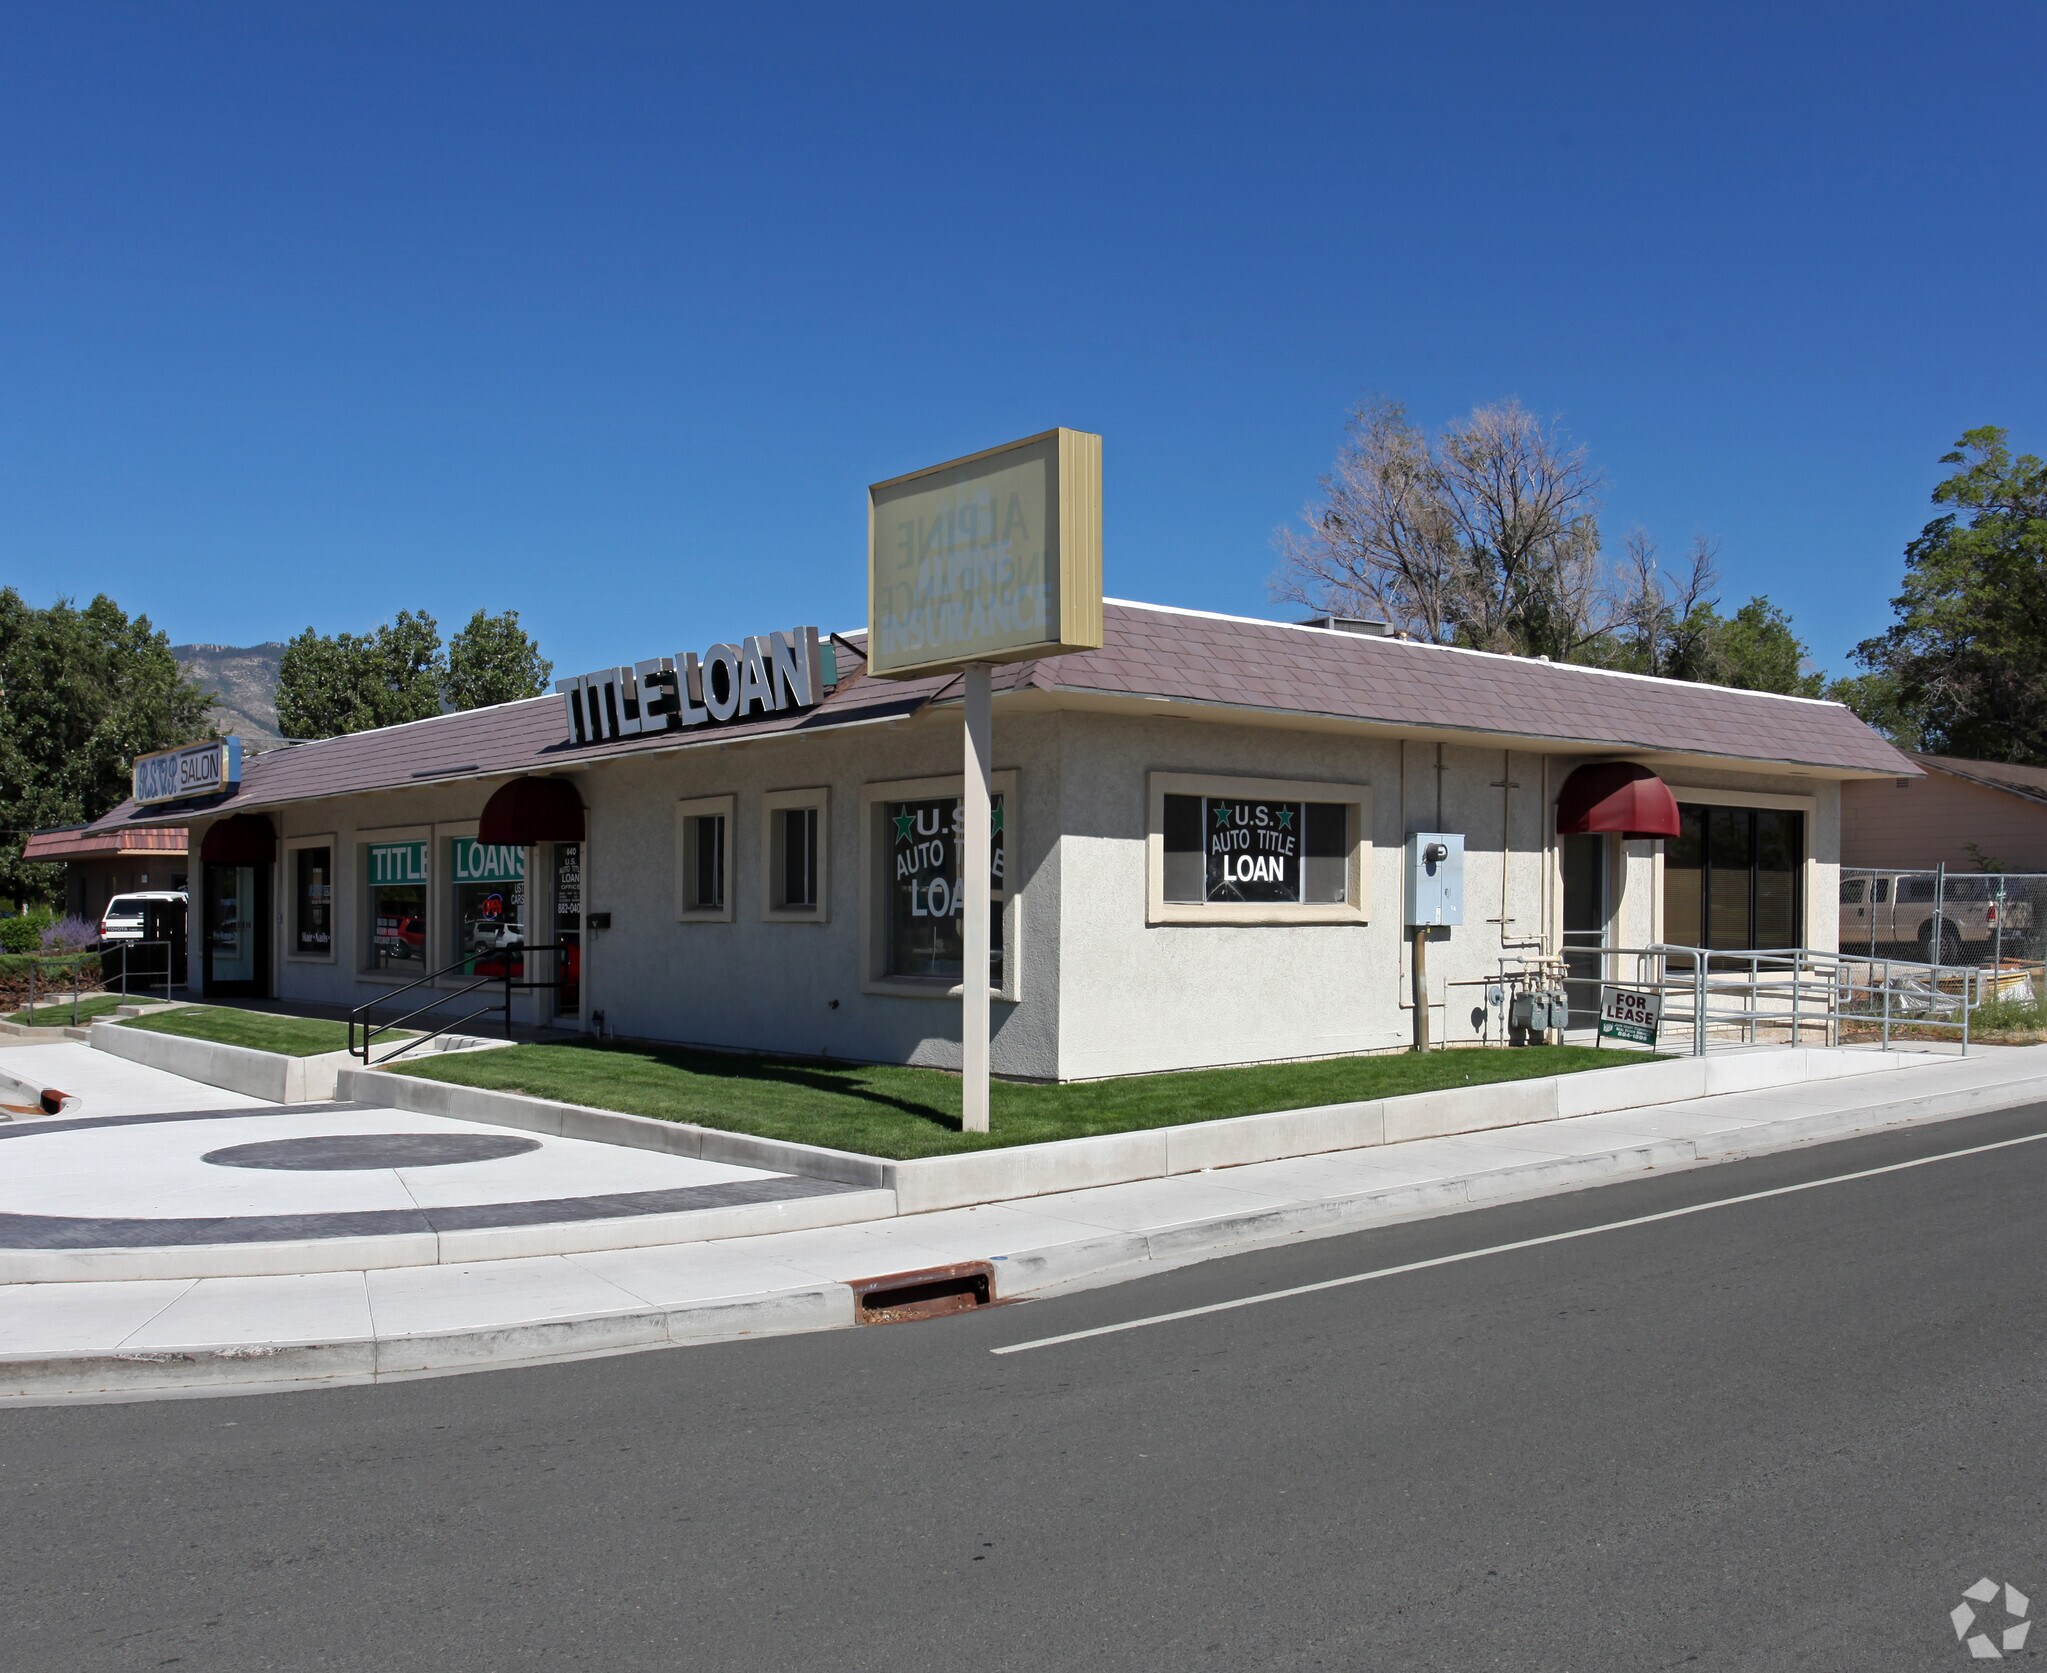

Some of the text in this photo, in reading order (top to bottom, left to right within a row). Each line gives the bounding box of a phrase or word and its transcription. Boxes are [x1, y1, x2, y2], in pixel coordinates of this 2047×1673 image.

[555, 625, 824, 744] TITLE LOAN
[181, 753, 219, 785] SALON
[917, 806, 965, 836] U.S
[1235, 805, 1274, 826] U.S.
[1211, 828, 1296, 857] AUTO TITLE
[559, 866, 571, 875] AUTO
[897, 839, 944, 881] AUTO
[1223, 854, 1284, 882] LOAN
[561, 873, 580, 883] LOAN
[481, 899, 503, 915] OPEN
[558, 902, 580, 914] 882-040
[912, 877, 965, 917] LOA
[1616, 993, 1647, 1010] FOR
[1606, 1005, 1654, 1025] LEASE
